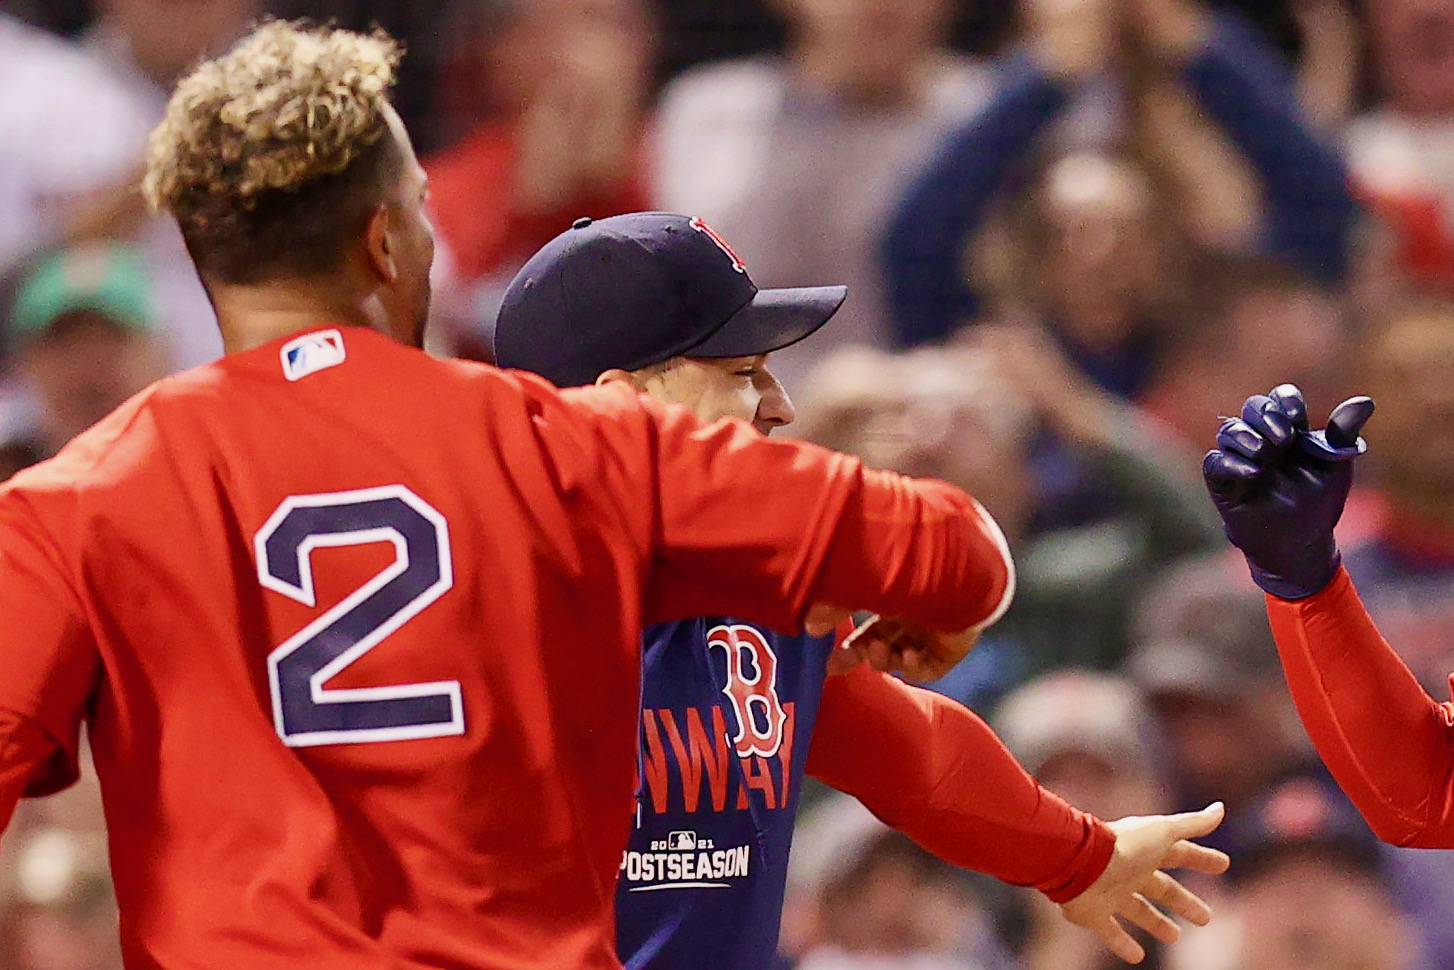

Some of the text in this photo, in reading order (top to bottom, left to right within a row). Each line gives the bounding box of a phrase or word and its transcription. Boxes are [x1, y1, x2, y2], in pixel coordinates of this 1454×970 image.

[253, 483, 465, 748] 2
[706, 624, 787, 758] B
[650, 839, 714, 851] 20 21
